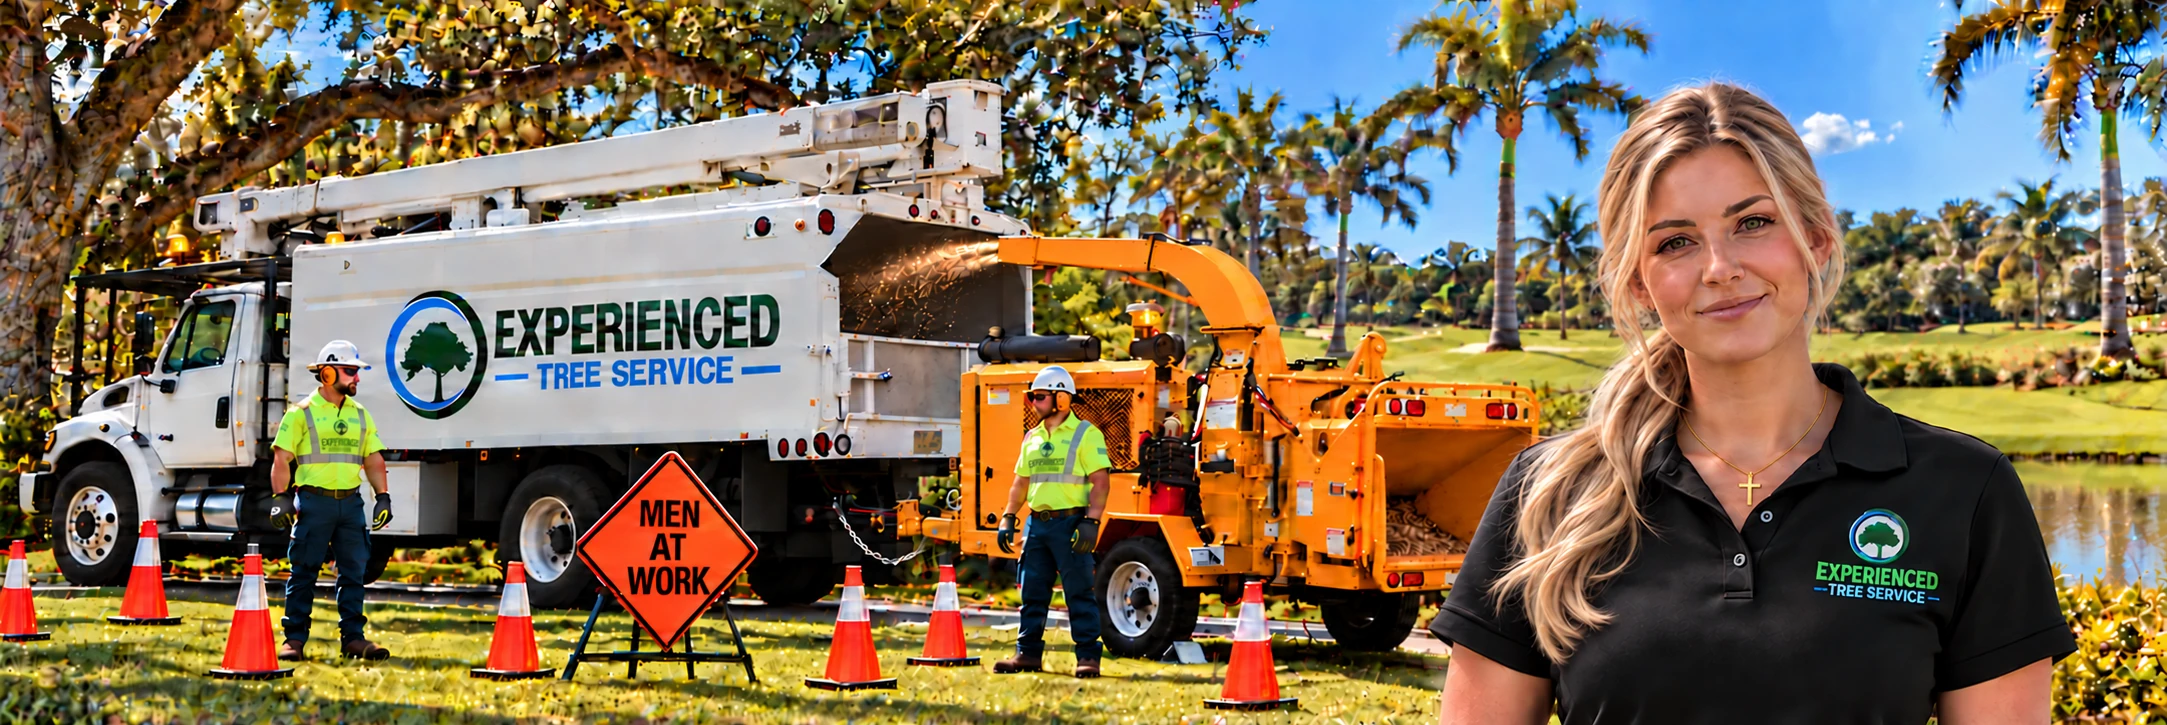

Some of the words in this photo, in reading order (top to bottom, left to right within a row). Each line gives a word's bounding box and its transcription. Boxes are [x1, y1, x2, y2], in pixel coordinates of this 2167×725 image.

[494, 294, 780, 358] EXPERIENCED
[537, 361, 601, 390] TREE
[611, 356, 734, 387] SERVICE
[640, 500, 700, 528] MEN
[649, 533, 687, 561] AT
[627, 566, 711, 595] WORK
[1815, 561, 1939, 590] EXPERIENCED
[1828, 583, 1863, 598] TREE
[1866, 586, 1926, 604] SERVICE
